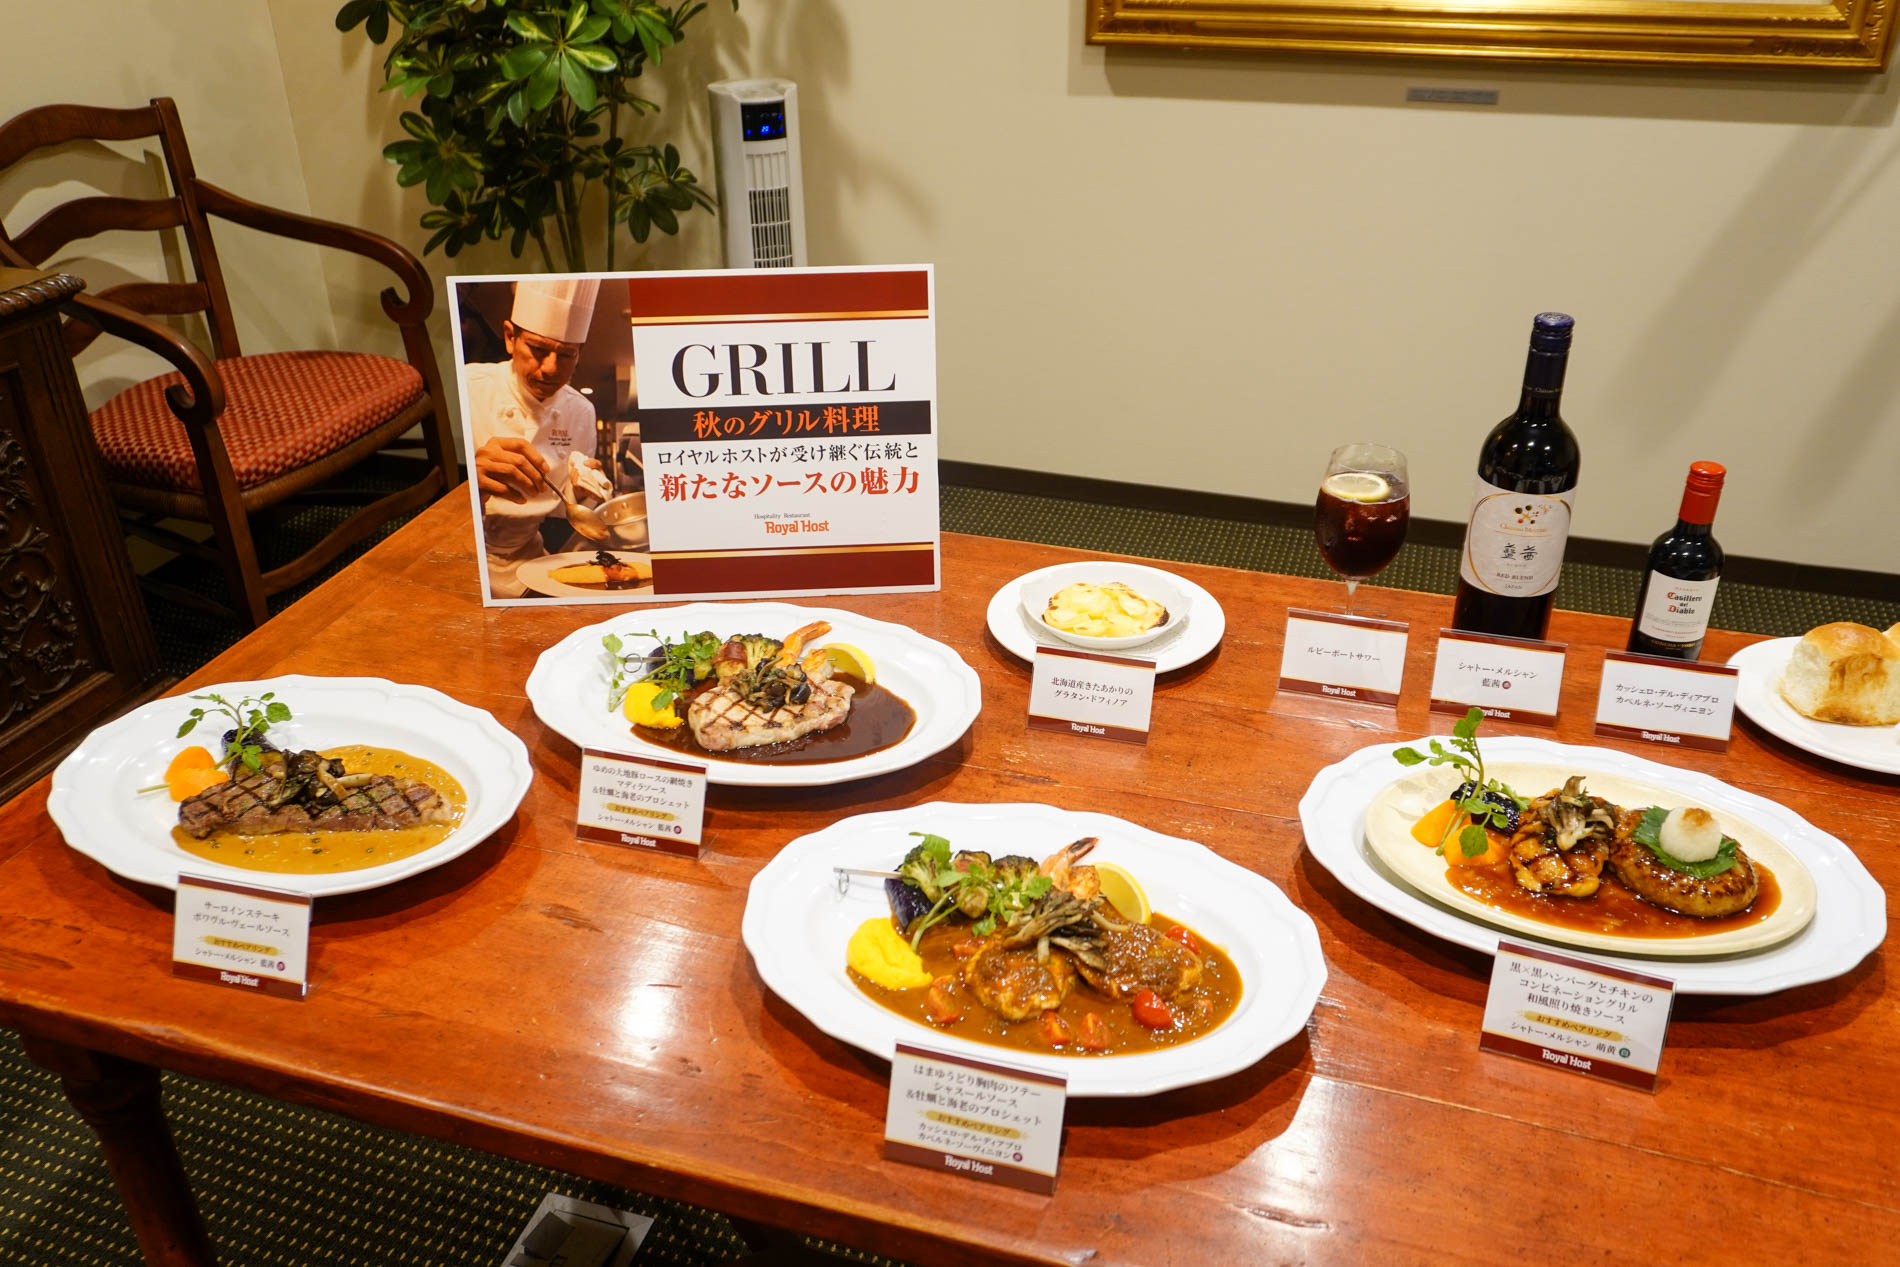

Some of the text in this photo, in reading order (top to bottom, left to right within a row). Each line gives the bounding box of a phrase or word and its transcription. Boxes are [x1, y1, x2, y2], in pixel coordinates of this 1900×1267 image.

[671, 340, 896, 398] GRILL
[692, 405, 880, 439] 秋のグリル料理
[657, 441, 919, 466] ロイヤルホストが受け継ぐ伝統と
[659, 466, 919, 502] 新たなソースの魅力
[764, 519, 830, 536] Royal Host
[1051, 677, 1134, 696] 北海道産きたあかりの
[1322, 685, 1357, 697] Royal Host
[1495, 709, 1511, 719] Host
[1071, 722, 1106, 735] Royal Host
[1642, 731, 1680, 743] Royal Host
[621, 833, 657, 847] Royal Host
[204, 901, 280, 922] サーロインステーキ
[220, 971, 259, 987] Royal Host
[1509, 961, 1654, 1004] 黒×黒ハンバーグとチキンの
[1519, 978, 1639, 1014] コンビネーショングリル
[1527, 992, 1625, 1025] 和風照り焼きソース
[1511, 1021, 1592, 1048] シャトー・メルシャン
[1535, 1015, 1613, 1038] おすすめペアリング
[1542, 1049, 1592, 1070] Royal Host
[913, 1064, 1041, 1098] はまゆうどり胸肉のソテー
[933, 1082, 1018, 1108] シャスールソース
[944, 1154, 994, 1176] Royal Host
